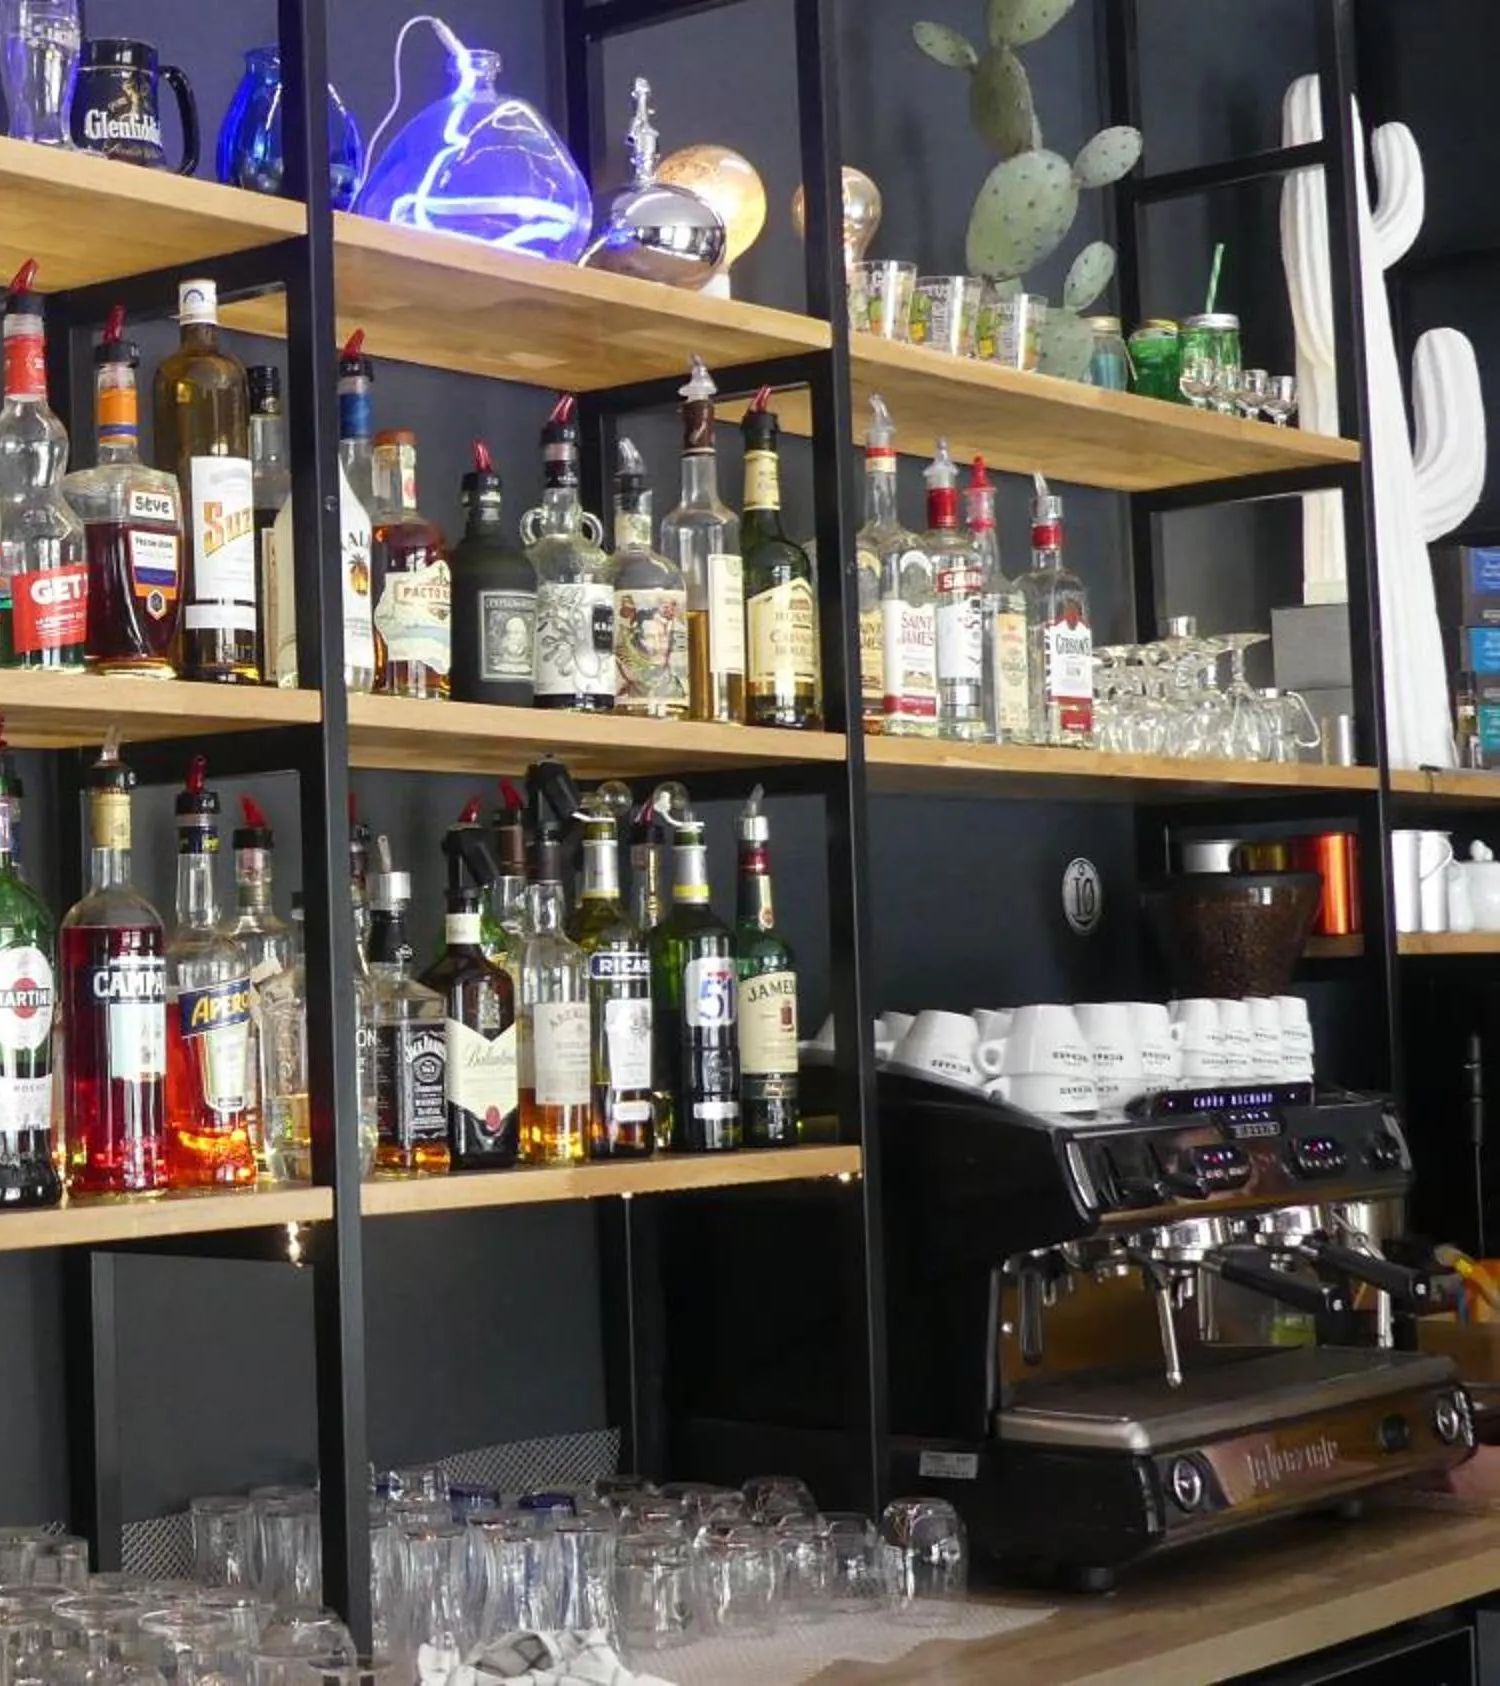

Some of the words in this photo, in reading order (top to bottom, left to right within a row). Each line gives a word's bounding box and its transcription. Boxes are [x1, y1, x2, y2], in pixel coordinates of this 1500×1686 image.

[202, 500, 252, 556] Suz
[30, 573, 81, 605] GET
[599, 957, 651, 974] RICAR
[93, 970, 167, 998] CAMPA
[191, 990, 249, 1027] APERO
